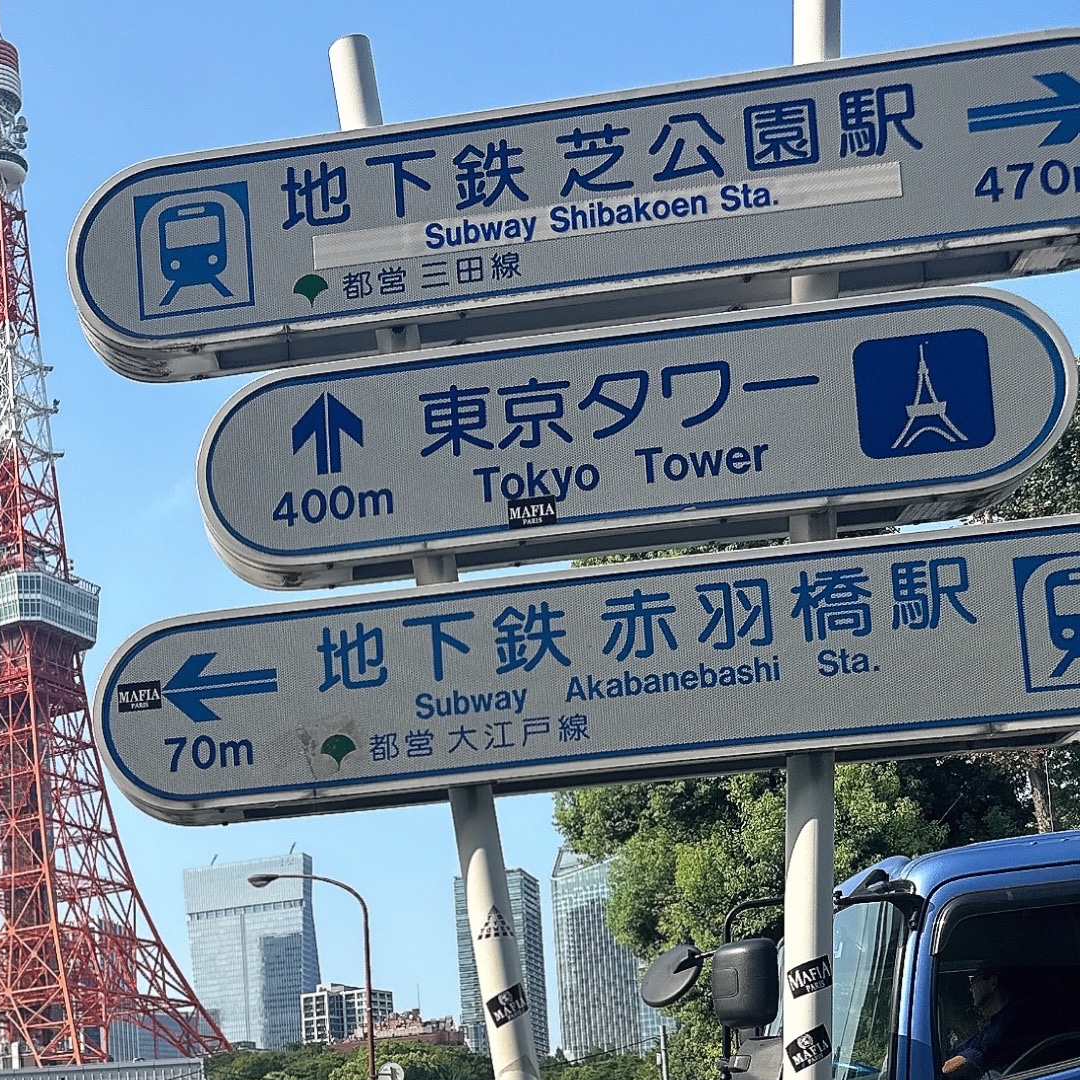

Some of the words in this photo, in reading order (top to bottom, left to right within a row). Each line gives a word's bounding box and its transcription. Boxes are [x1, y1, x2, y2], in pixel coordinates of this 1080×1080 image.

[974, 159, 1080, 203] 470
[425, 215, 537, 250] Subway
[549, 193, 708, 233] Shibakoen
[721, 183, 778, 213] Sta.
[419, 360, 819, 458] 東京タワー
[472, 460, 600, 503] Tokyo
[634, 441, 769, 485] Tower
[272, 485, 394, 527] 400m
[509, 502, 555, 520] MAFIA
[522, 517, 543, 525] PARIS
[118, 688, 161, 704] MAFIA
[415, 687, 528, 720] Subway
[566, 654, 781, 702] Akabanebashi
[818, 648, 881, 678] Sta.
[164, 733, 254, 773] 70m
[787, 960, 831, 992] MAFIA
[493, 997, 526, 1022] MAFIA
[791, 1039, 829, 1066] MAFIA
